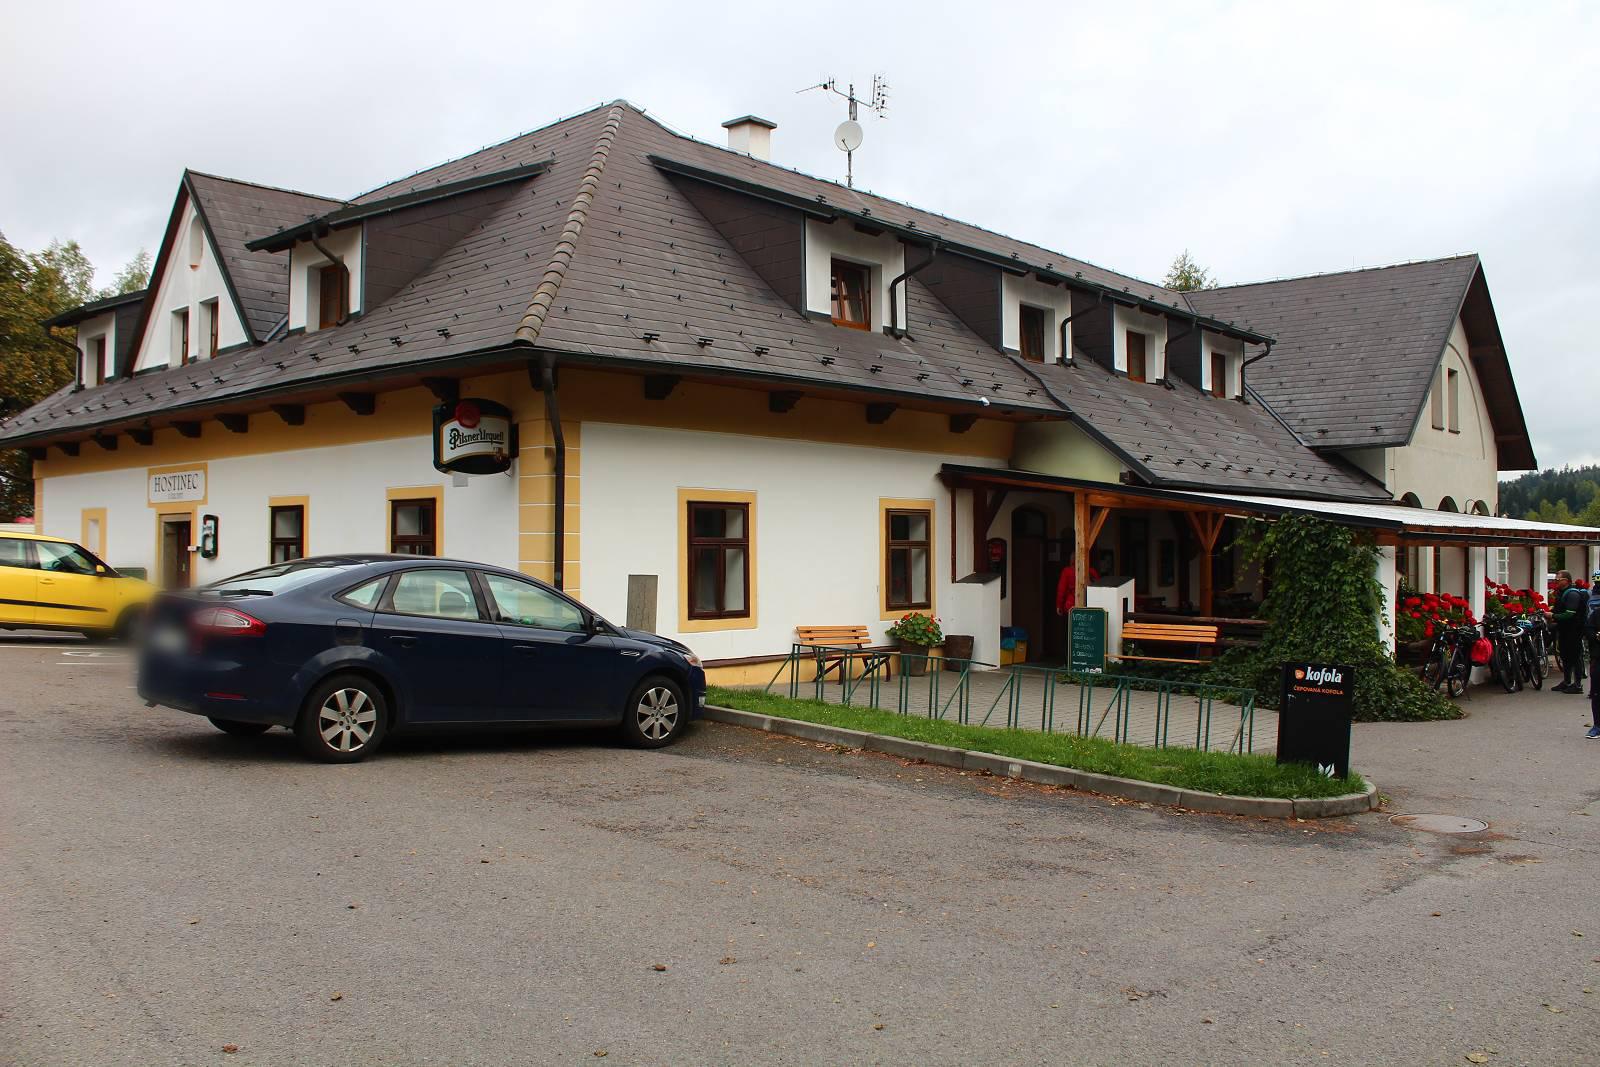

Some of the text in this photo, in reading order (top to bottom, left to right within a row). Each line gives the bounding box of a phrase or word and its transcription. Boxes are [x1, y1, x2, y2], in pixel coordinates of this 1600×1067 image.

[449, 427, 504, 450] Pilsner Urquell
[154, 473, 199, 492] HOSTINEC
[1305, 666, 1342, 685] kofola
